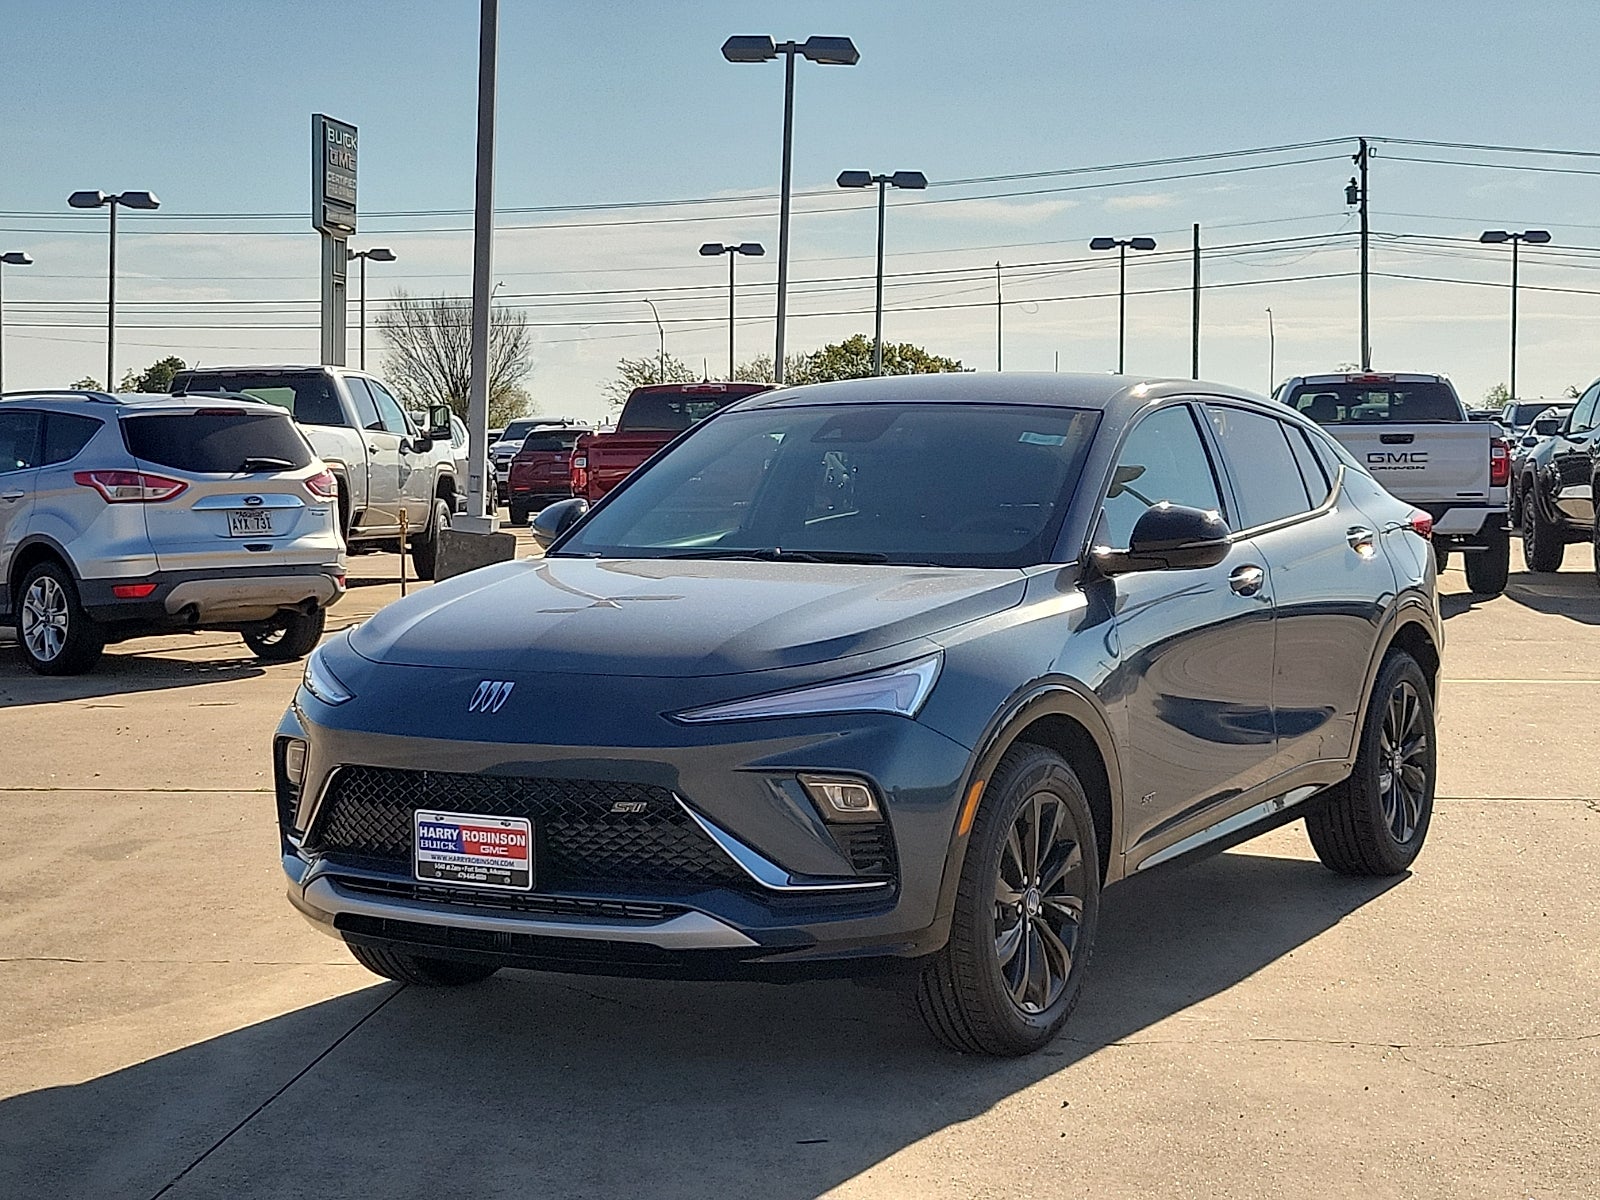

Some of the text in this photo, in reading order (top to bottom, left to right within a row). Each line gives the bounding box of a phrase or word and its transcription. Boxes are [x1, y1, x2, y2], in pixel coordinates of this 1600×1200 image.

[327, 127, 357, 150] BUICK
[1367, 453, 1428, 463] GMC
[419, 826, 526, 846] HARRY ROBINSON
[420, 839, 509, 855] BUICK GMC
